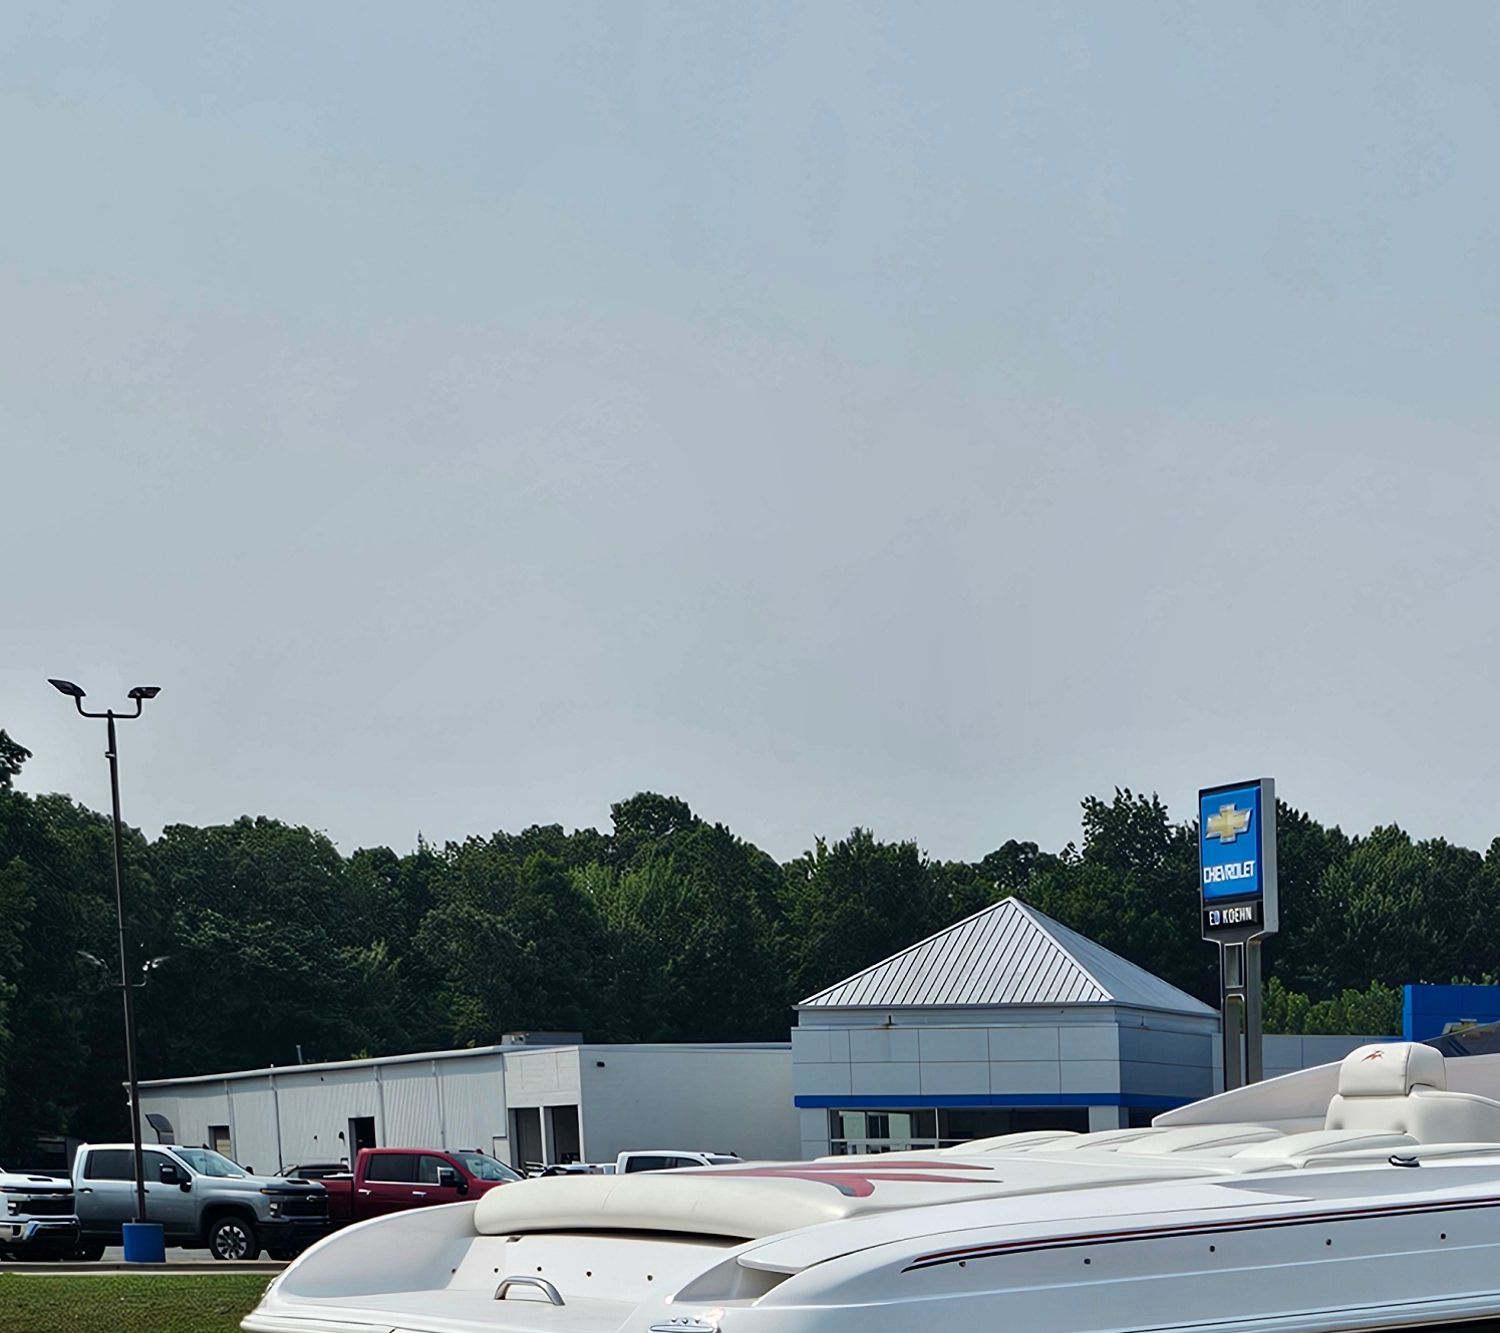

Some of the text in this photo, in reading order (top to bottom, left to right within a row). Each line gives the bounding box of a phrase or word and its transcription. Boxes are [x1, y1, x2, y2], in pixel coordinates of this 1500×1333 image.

[1204, 861, 1255, 883] CHEVROLET
[1209, 907, 1252, 926] ED KOEHN
